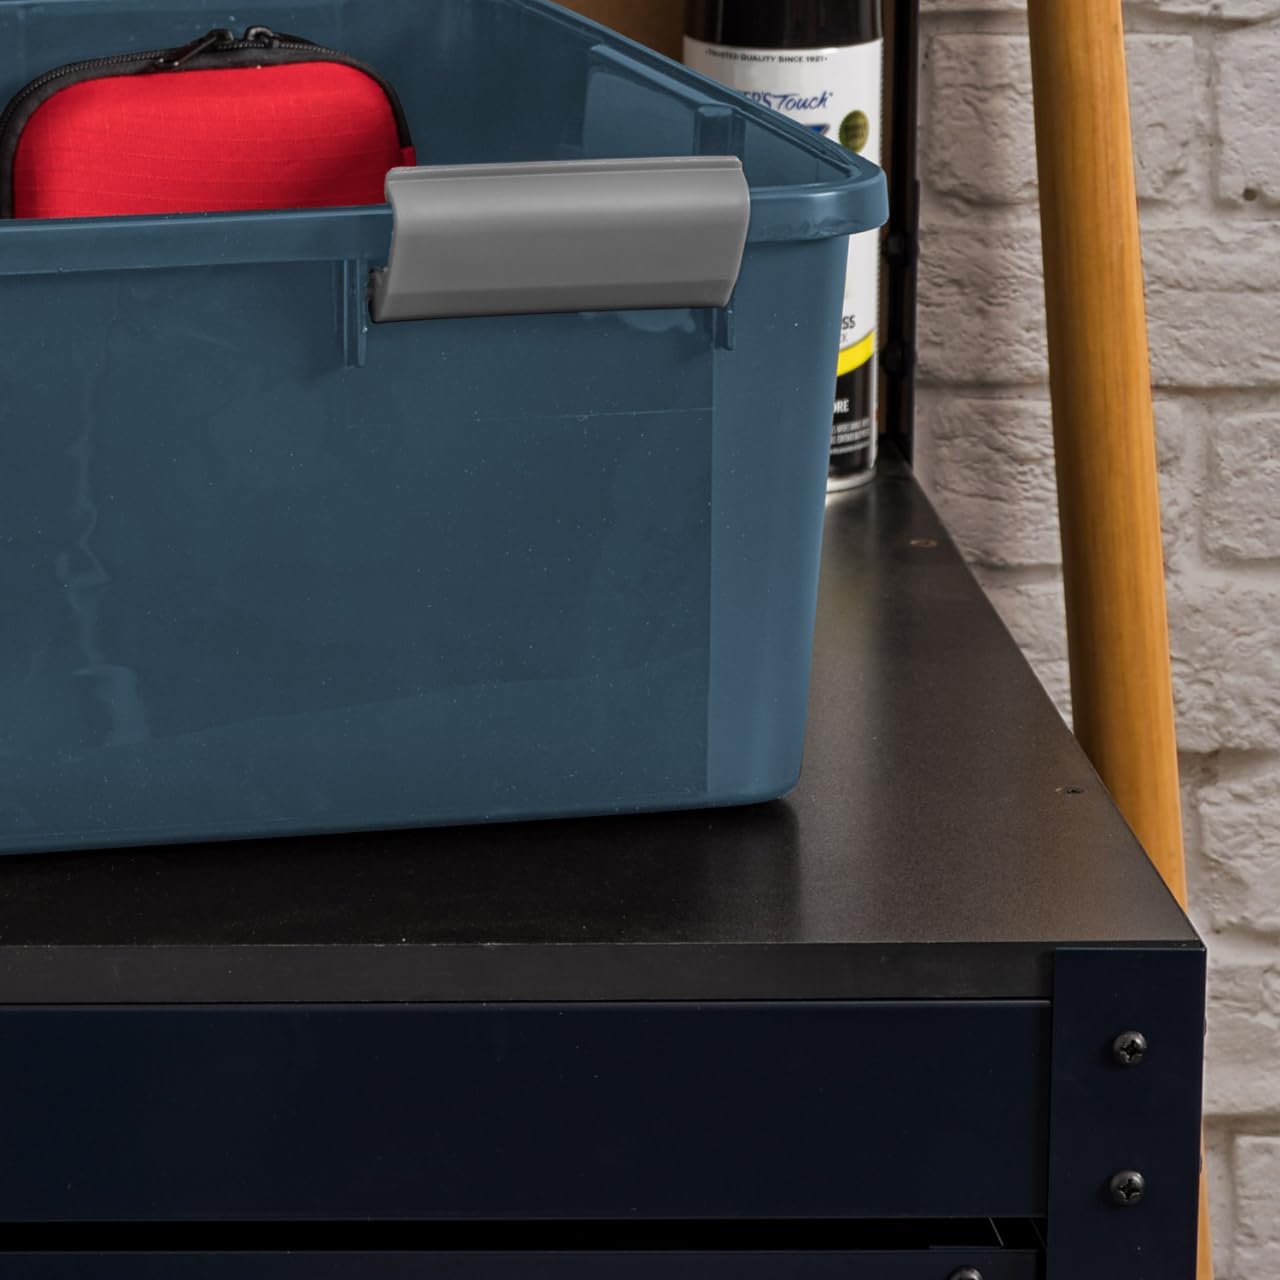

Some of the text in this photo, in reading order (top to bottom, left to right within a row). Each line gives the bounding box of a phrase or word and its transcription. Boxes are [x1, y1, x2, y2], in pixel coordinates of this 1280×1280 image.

[741, 55, 776, 63] QUALITY
[778, 55, 804, 63] SINCE
[772, 90, 828, 111] Touch
